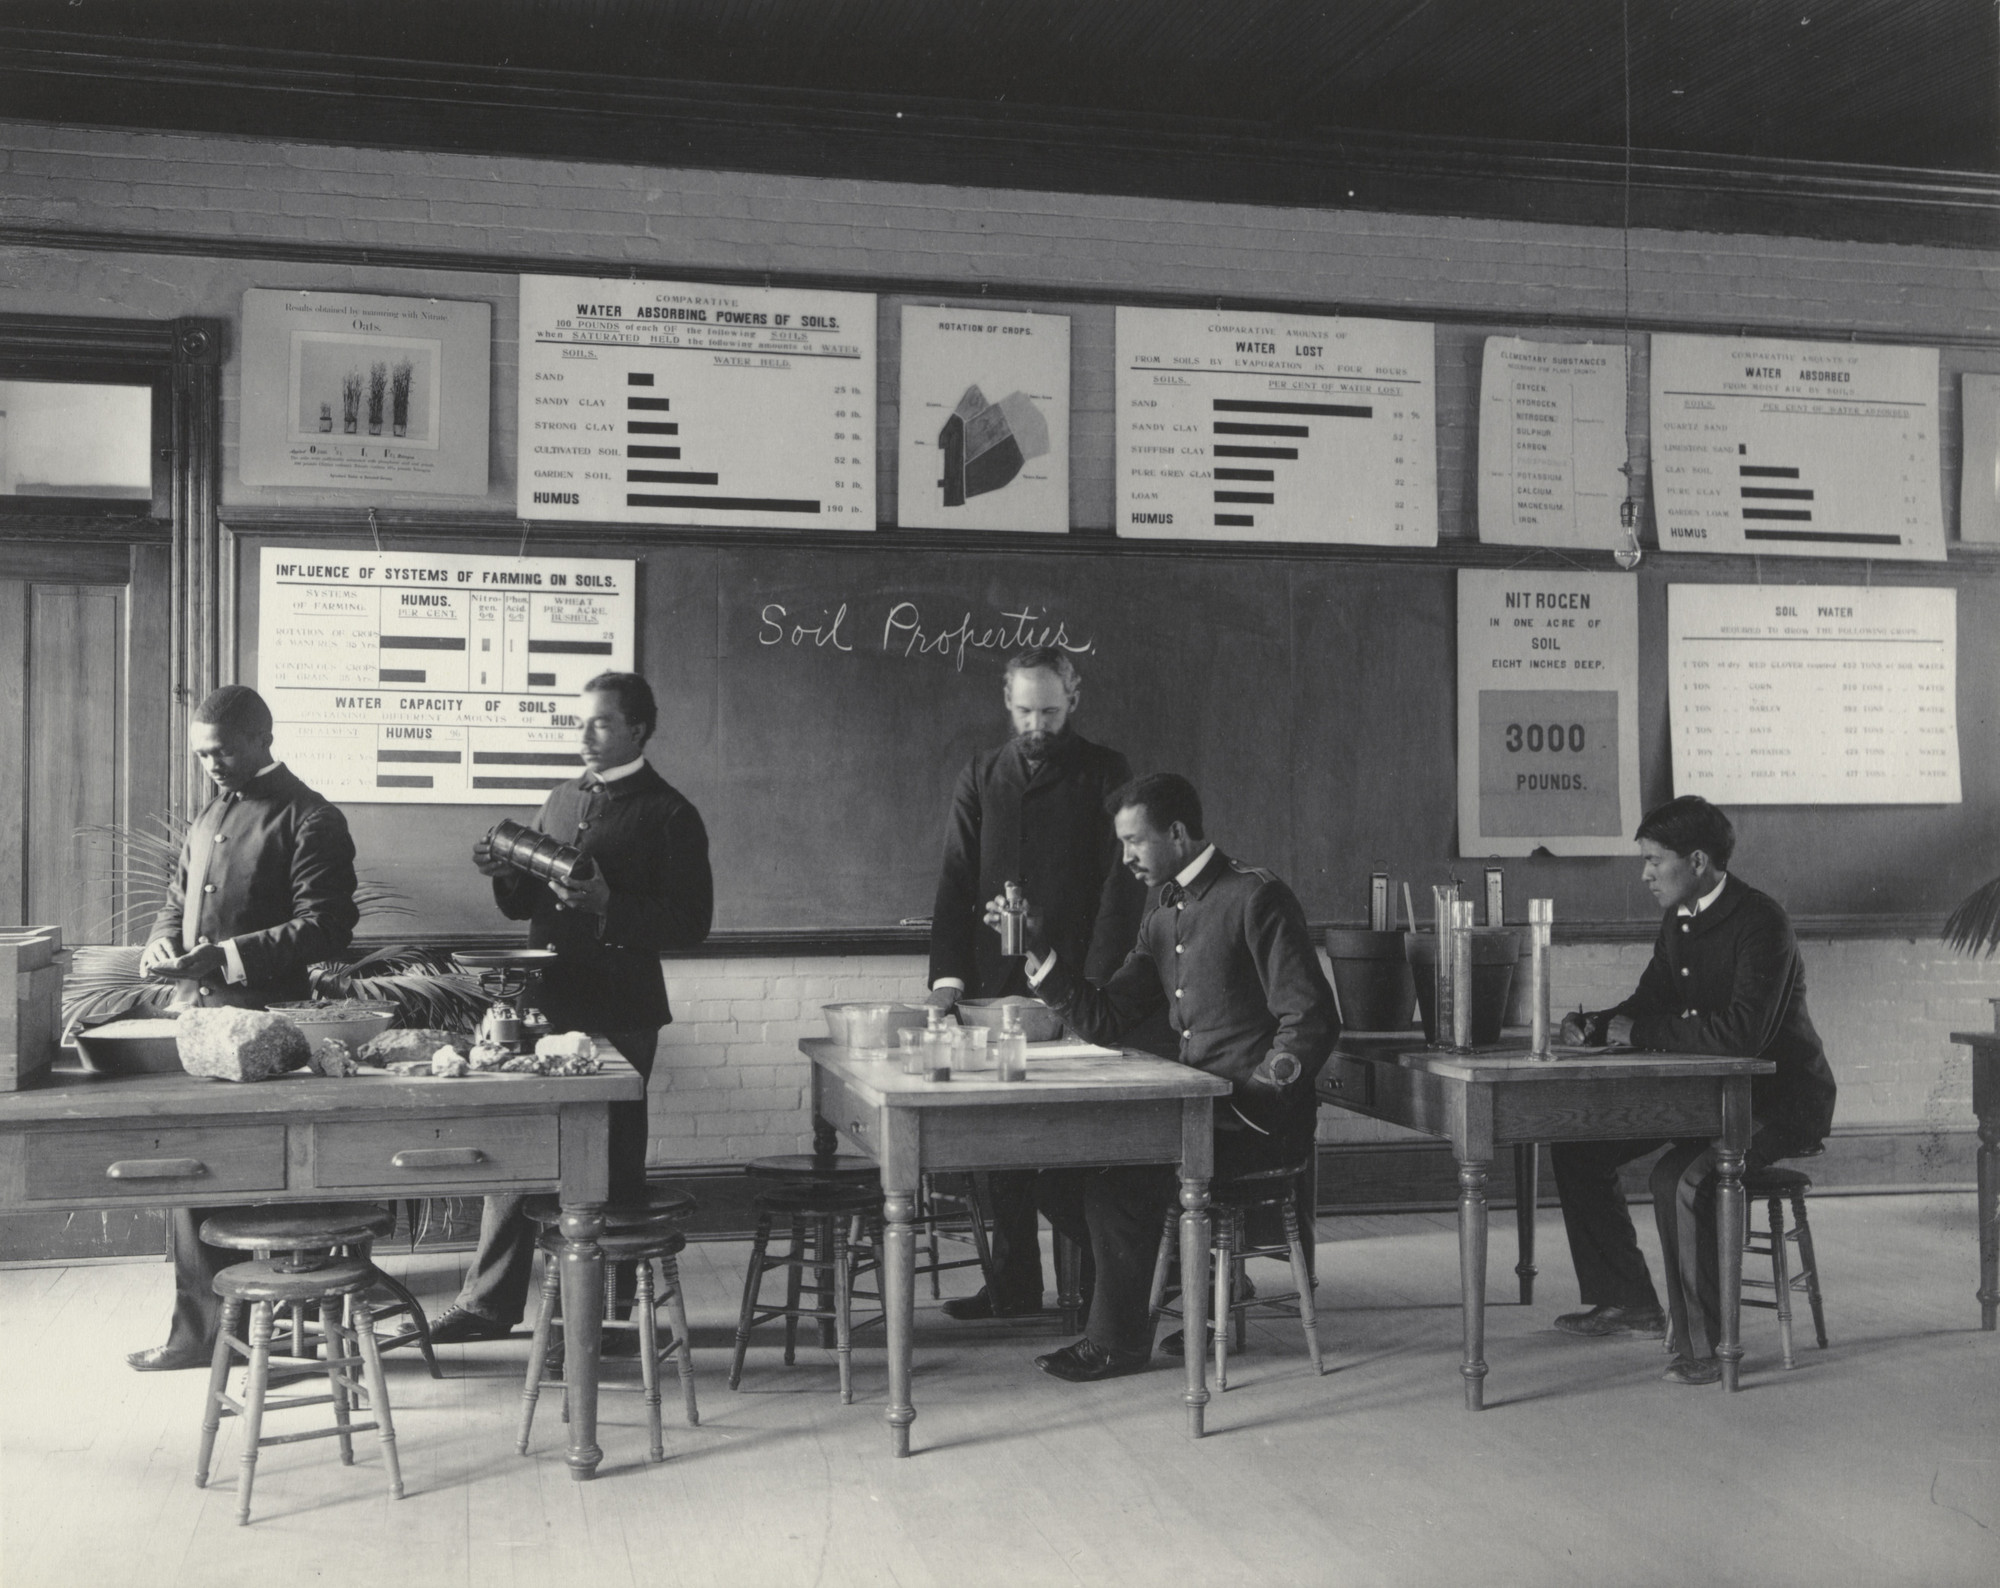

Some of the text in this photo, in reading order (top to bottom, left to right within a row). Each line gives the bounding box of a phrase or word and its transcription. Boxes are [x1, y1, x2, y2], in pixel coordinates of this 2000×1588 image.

[656, 294, 738, 307] COMPARATIVE
[285, 303, 313, 312] Results
[315, 305, 347, 315] obtained
[350, 306, 358, 317] by
[401, 310, 418, 319] with
[577, 304, 840, 328] WATER ABSORBING POWERS OF SOILS.
[352, 319, 382, 332] Oats.
[556, 319, 808, 340] 100 POUNDS of each OF the following SOILS
[939, 322, 1034, 336] ROTATION OF CROPS.
[1208, 324, 1276, 335] COMPARATIVE
[1286, 329, 1329, 339] AMOUNTS
[537, 330, 563, 339] when
[572, 331, 640, 342] SATURATED
[650, 335, 680, 344] HELD
[688, 336, 704, 345] the
[708, 338, 753, 349] following
[758, 341, 797, 350] amounts
[1236, 341, 1324, 357] WATER LOST
[713, 356, 751, 366] WATER
[1135, 355, 1161, 363] FROM
[1173, 357, 1200, 365] SOILS
[1210, 358, 1223, 366] BY
[1235, 359, 1302, 369] EVAPORATION
[1314, 363, 1325, 371] IN
[1337, 365, 1363, 373] FOUR
[1552, 356, 1607, 366] SUBSTANCES
[535, 373, 564, 381] SAND
[1745, 367, 1851, 383] WATER ABSORBED
[1268, 380, 1372, 393] PER CENT OF WATER
[535, 397, 606, 407] SANDY CLAY
[1131, 400, 1158, 408] SAND
[534, 422, 615, 431] STRONG CLAY
[1131, 423, 1199, 432] SANDY CLAY
[1704, 424, 1728, 432] SAND
[534, 446, 591, 455] CULTIVATED
[1181, 447, 1205, 455] CLAY
[534, 470, 574, 478] GARDEN
[1131, 468, 1212, 478] PURE GREY CLAY
[533, 491, 580, 505] HUMUS
[1131, 492, 1158, 500] LOAM
[827, 505, 844, 513] 190
[1131, 512, 1174, 524] HUMUS
[1670, 527, 1708, 539] HUMUS
[276, 564, 616, 588] INFLUENCE OF SYSTEMS OF FARMING ON SOILS.
[306, 589, 358, 599] SYSTEMS
[401, 594, 451, 607] HUMUS.
[554, 597, 593, 606] WHEAT
[1505, 592, 1591, 610] NITROGEN
[398, 609, 418, 617] PER
[543, 605, 564, 614] PER
[1775, 606, 1853, 618] SOIL WATER
[759, 603, 853, 651] Soil
[1490, 618, 1601, 628] IN ONE ACRE OF
[1531, 637, 1561, 650] SOIL
[1529, 660, 1567, 669] INCHES
[1574, 660, 1605, 670] DEEP.
[335, 697, 556, 713] WATER CAPACITY OF SOILS
[386, 727, 433, 739] HUMUS
[528, 732, 564, 740] WATER
[1505, 724, 1586, 753] 3000
[1516, 773, 1587, 791] POUNDS.
